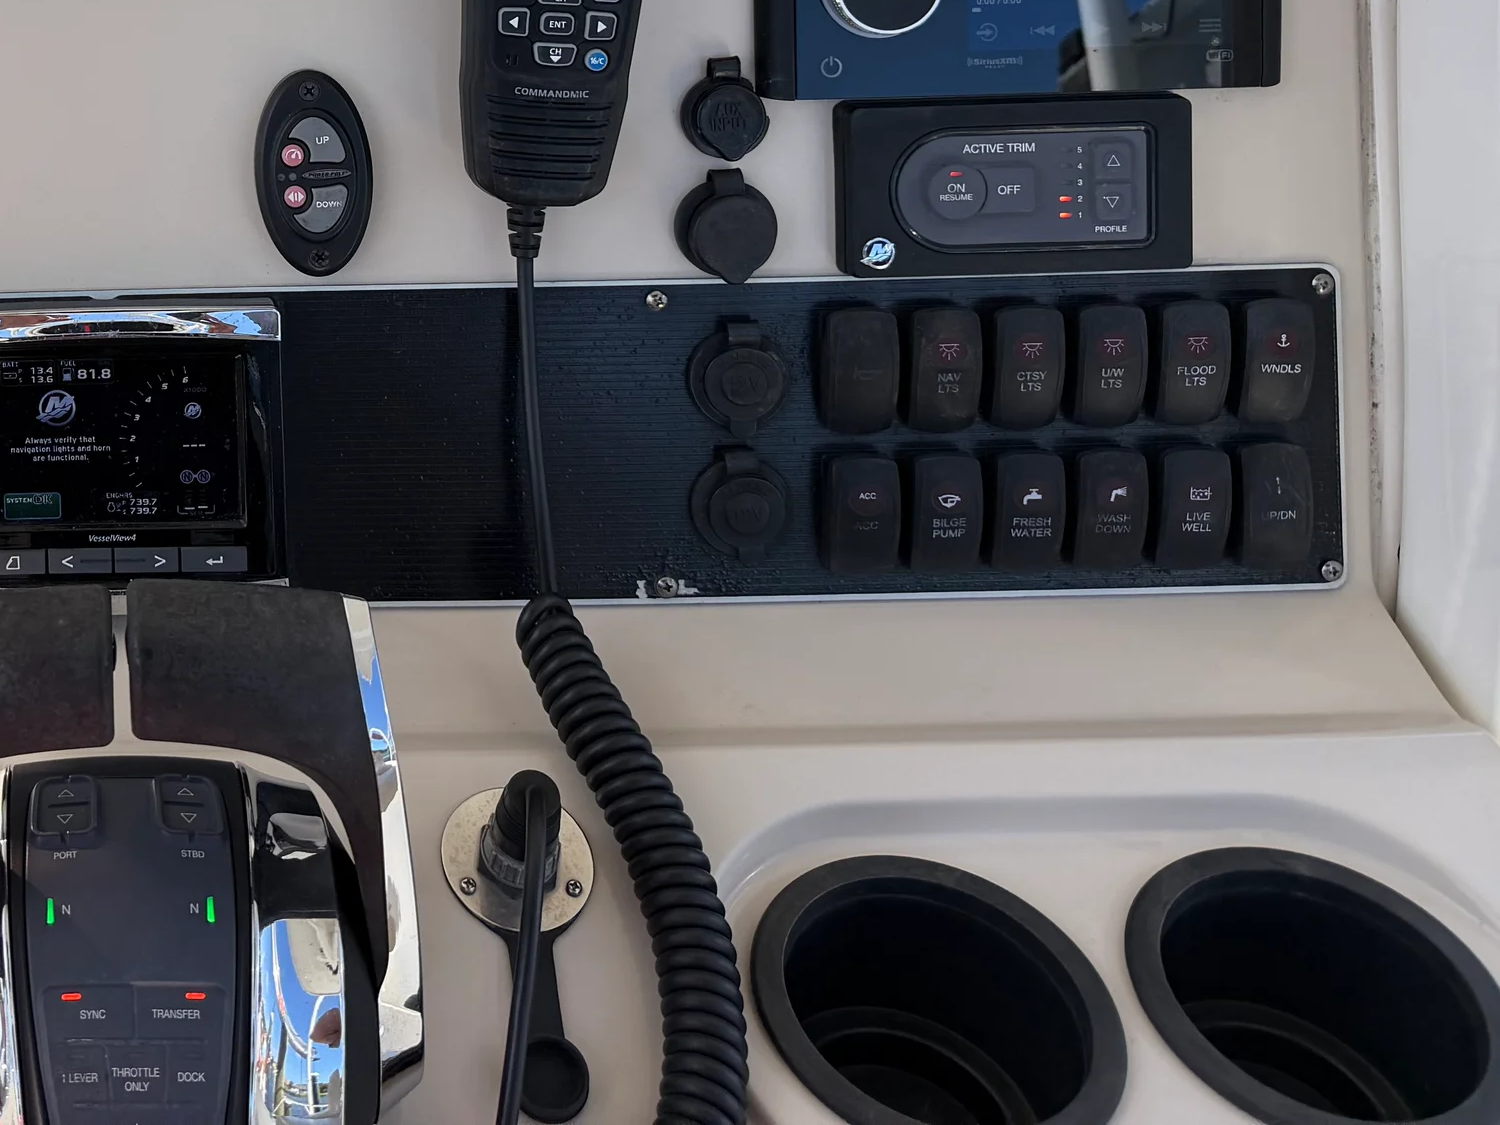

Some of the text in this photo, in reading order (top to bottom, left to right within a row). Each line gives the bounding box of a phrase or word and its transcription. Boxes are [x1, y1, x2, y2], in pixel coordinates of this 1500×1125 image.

[549, 20, 567, 30] ENT
[549, 47, 562, 56] CH
[514, 86, 590, 99] COMMANDMIC
[315, 136, 330, 145] UP
[963, 142, 1036, 155] ACTIVE TRIM
[1077, 146, 1083, 154] 5
[1077, 162, 1083, 170] 4
[1077, 178, 1083, 186] 3
[947, 183, 965, 194] ON
[997, 185, 1021, 195] OFF
[939, 193, 973, 202] RESUME
[1077, 195, 1083, 203] 2
[316, 200, 343, 208] DOWN
[1078, 211, 1082, 219] 1
[1095, 225, 1128, 233] PROFILE
[30, 366, 53, 375] 13.4
[1102, 368, 1124, 378] U/W
[1177, 365, 1216, 376] FLOOD
[1261, 363, 1302, 374] WNDLS
[31, 375, 54, 383] 13.6
[77, 368, 111, 380] 81.8
[937, 372, 962, 383] NAV
[1016, 371, 1047, 382] CTSY
[161, 382, 168, 390] 5
[1020, 382, 1042, 392] LTS
[1101, 379, 1123, 389] LTS
[1185, 377, 1207, 387] LTS
[938, 383, 960, 394] LTS
[24, 435, 96, 445] Always verify that
[10, 444, 111, 454] navigation lights and horn
[47, 454, 89, 462] functional.
[859, 492, 877, 500] ACC
[129, 498, 158, 506] 739.7
[130, 507, 158, 515] 739.7
[1097, 513, 1132, 523] WASH
[1186, 511, 1211, 522] LIVE
[933, 517, 967, 528] BILGE
[1012, 517, 1051, 527] FRESH
[1181, 522, 1212, 532] WELL
[932, 528, 966, 538] PUMP
[1010, 527, 1052, 538] WATER
[1095, 524, 1132, 534] DOWN
[53, 850, 78, 860] PORT
[180, 849, 205, 858] STBD
[61, 904, 71, 915] N
[189, 903, 199, 914] N
[80, 1009, 106, 1020] SYNC
[152, 1009, 201, 1020] TRANSFER
[68, 1072, 99, 1083] LEVER
[111, 1067, 160, 1078] THROTTLE
[177, 1072, 206, 1083] DOCK
[124, 1081, 150, 1092] ONLY
